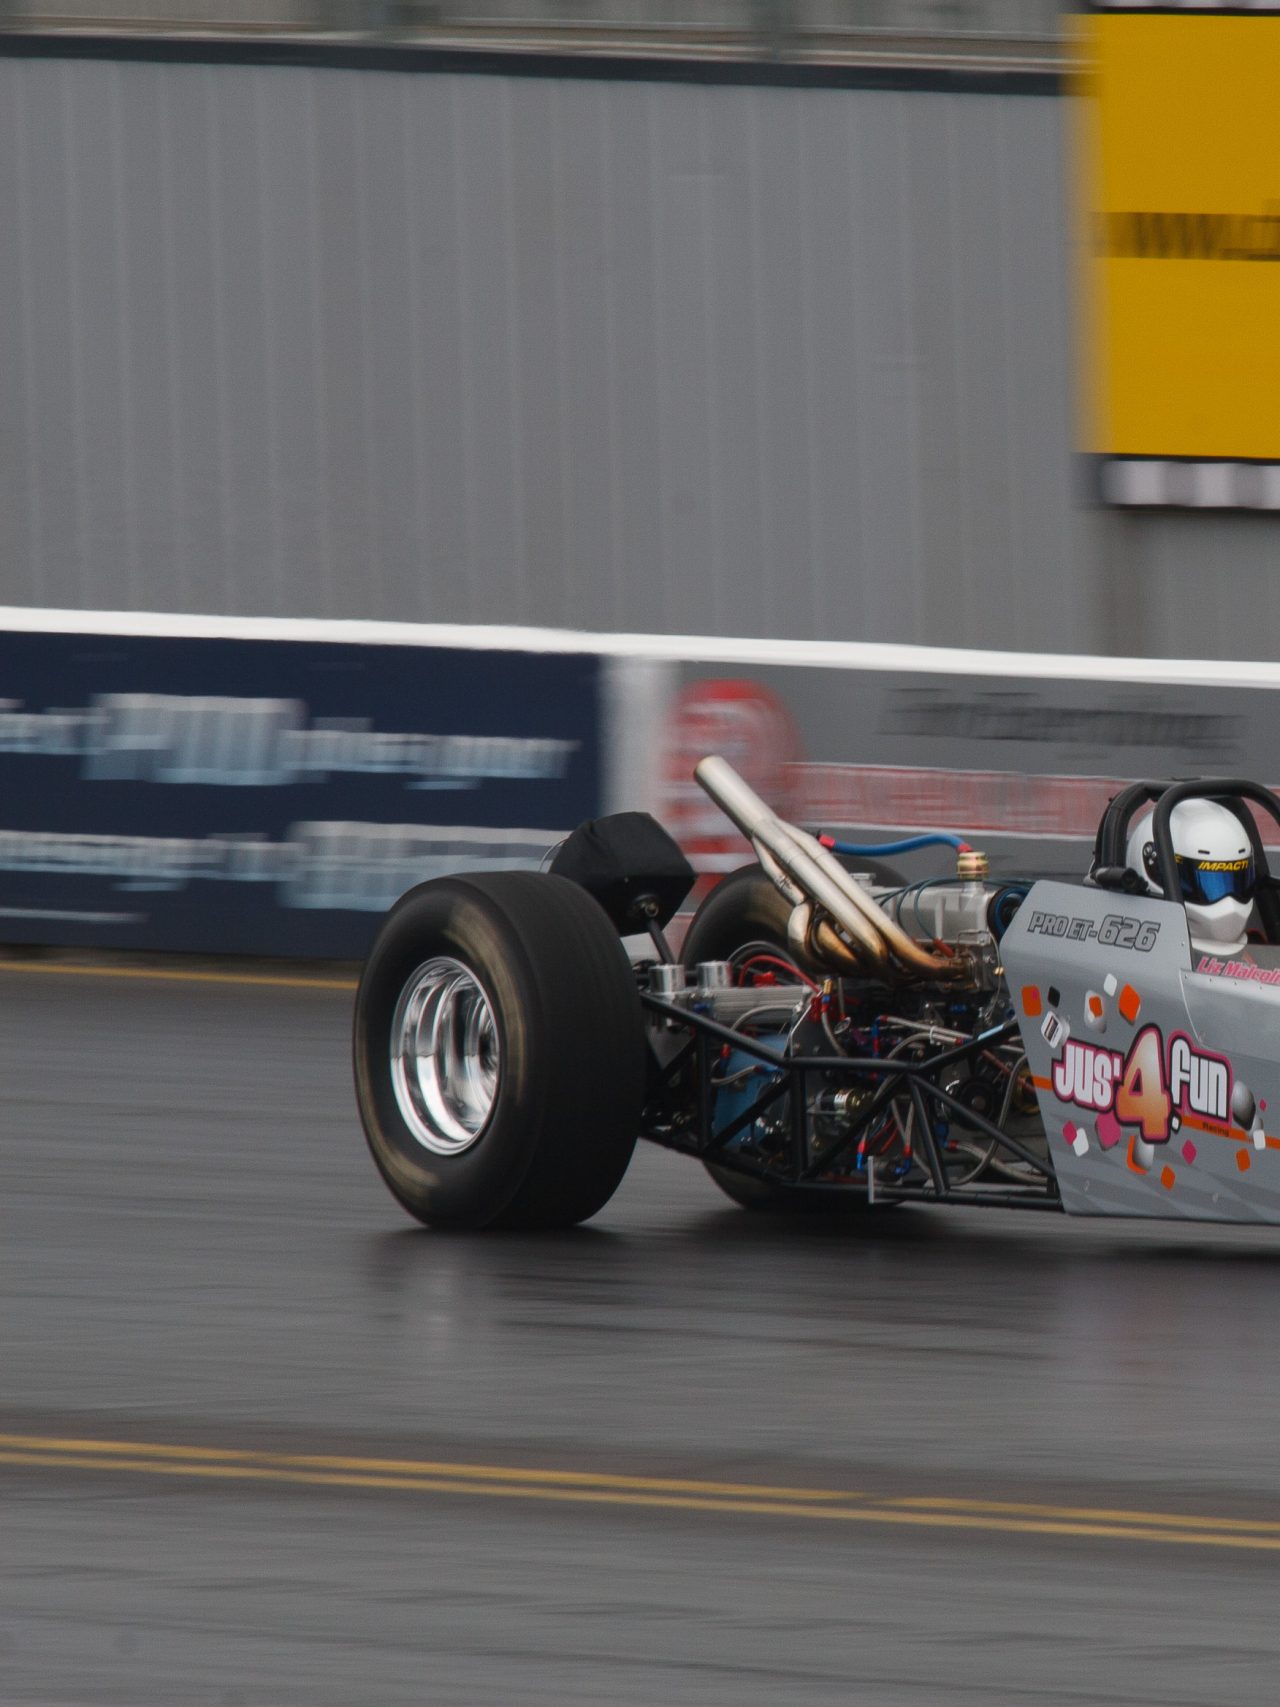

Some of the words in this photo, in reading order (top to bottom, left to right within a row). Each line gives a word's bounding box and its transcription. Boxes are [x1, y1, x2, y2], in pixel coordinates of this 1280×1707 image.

[1027, 911, 1069, 937] PRO
[1197, 956, 1224, 974] Liz
[1118, 1025, 1171, 1143] 4
